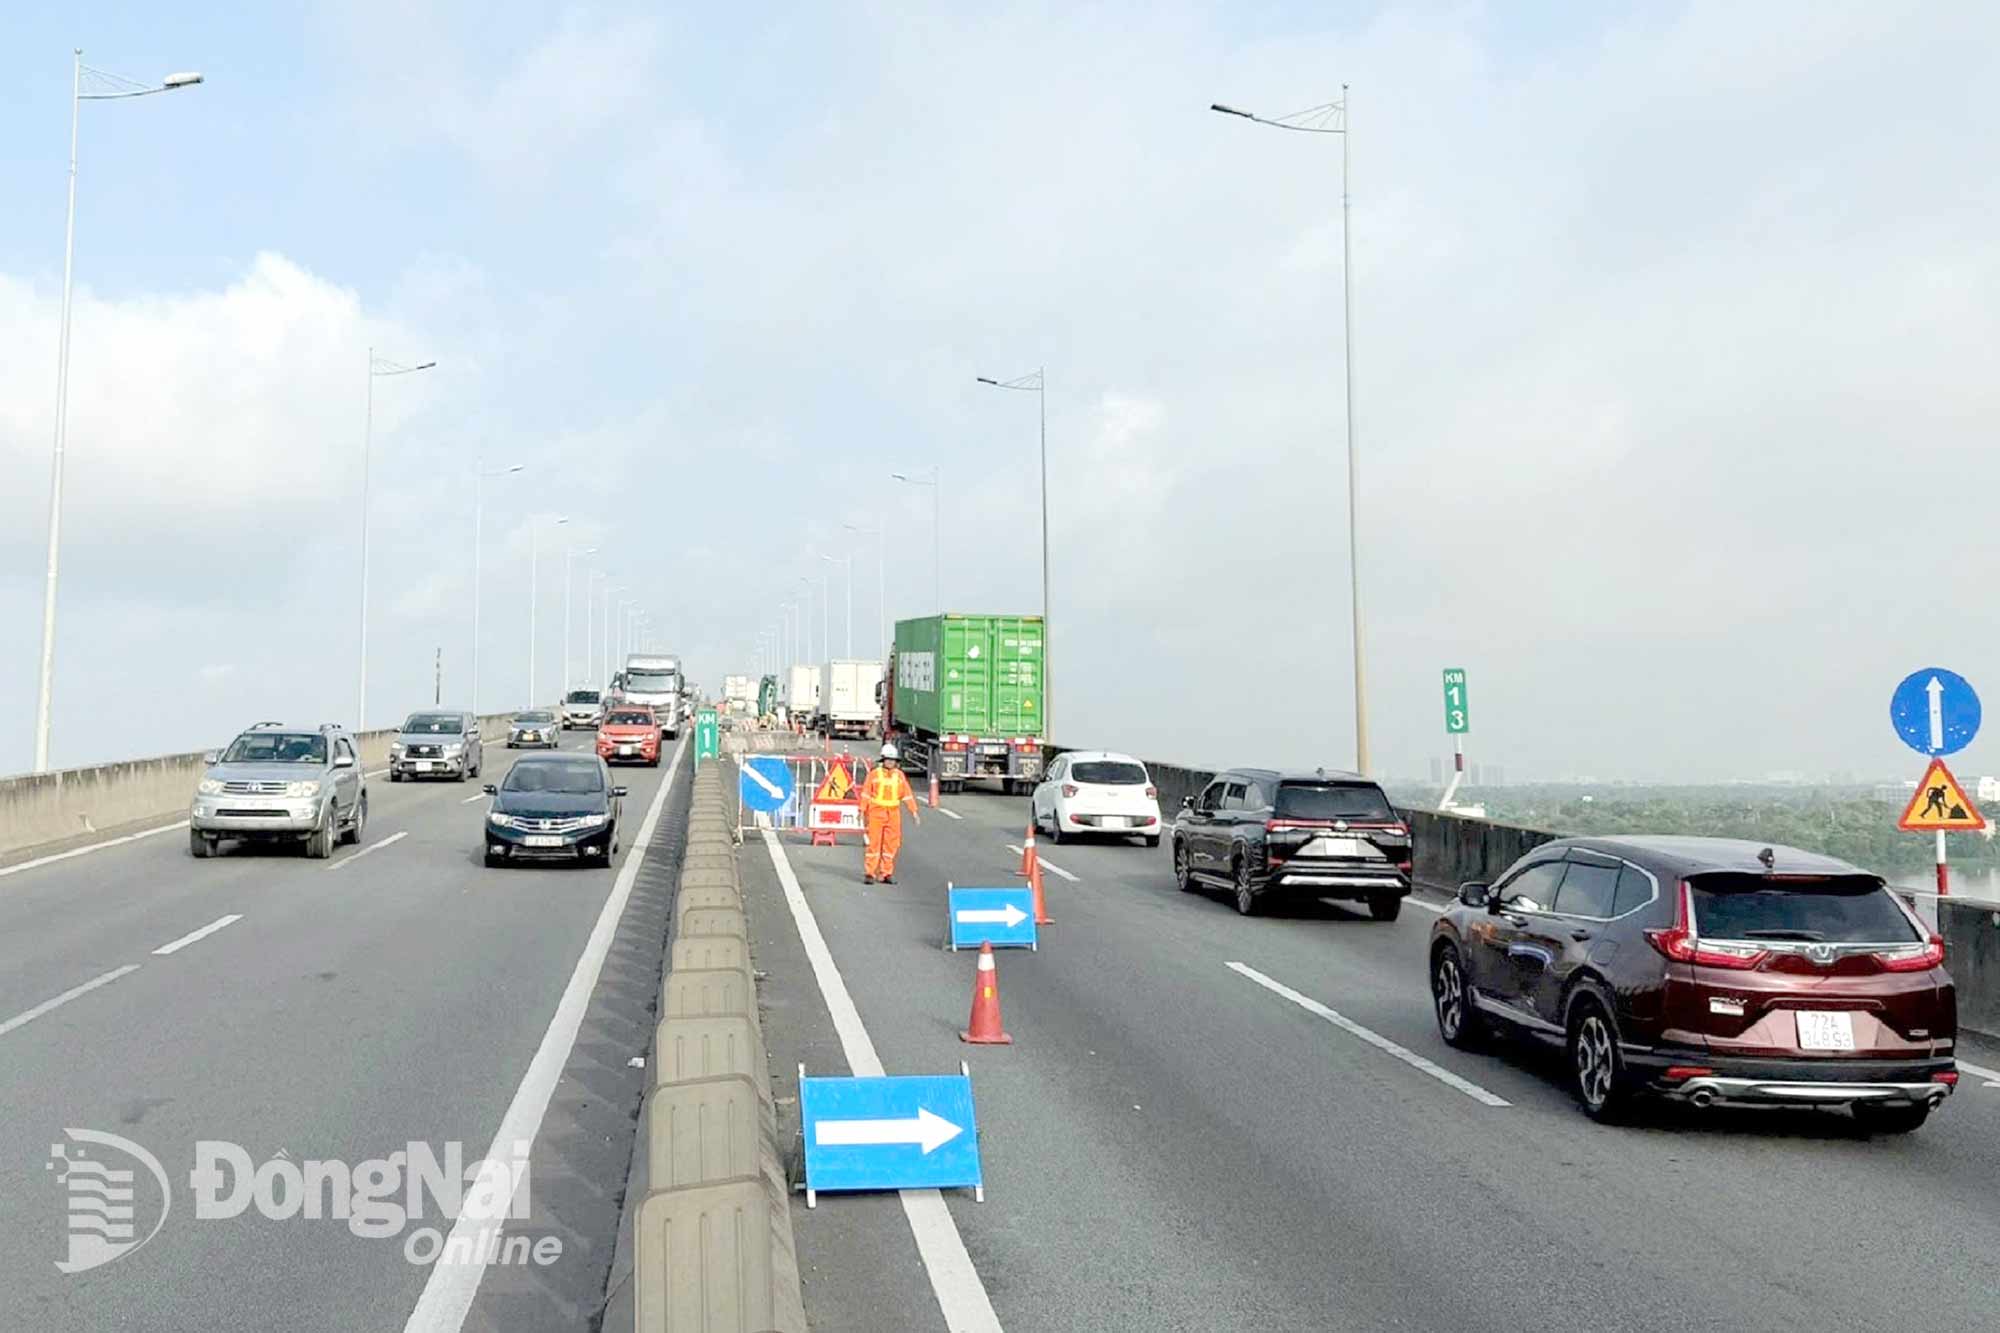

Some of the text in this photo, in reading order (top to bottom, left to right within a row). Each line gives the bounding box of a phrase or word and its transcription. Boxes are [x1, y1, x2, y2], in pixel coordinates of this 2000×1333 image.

[1445, 671, 1464, 684] KM
[1447, 686, 1460, 706] 1
[698, 713, 716, 725] KM
[1450, 709, 1464, 730] 3
[703, 727, 711, 749] 1
